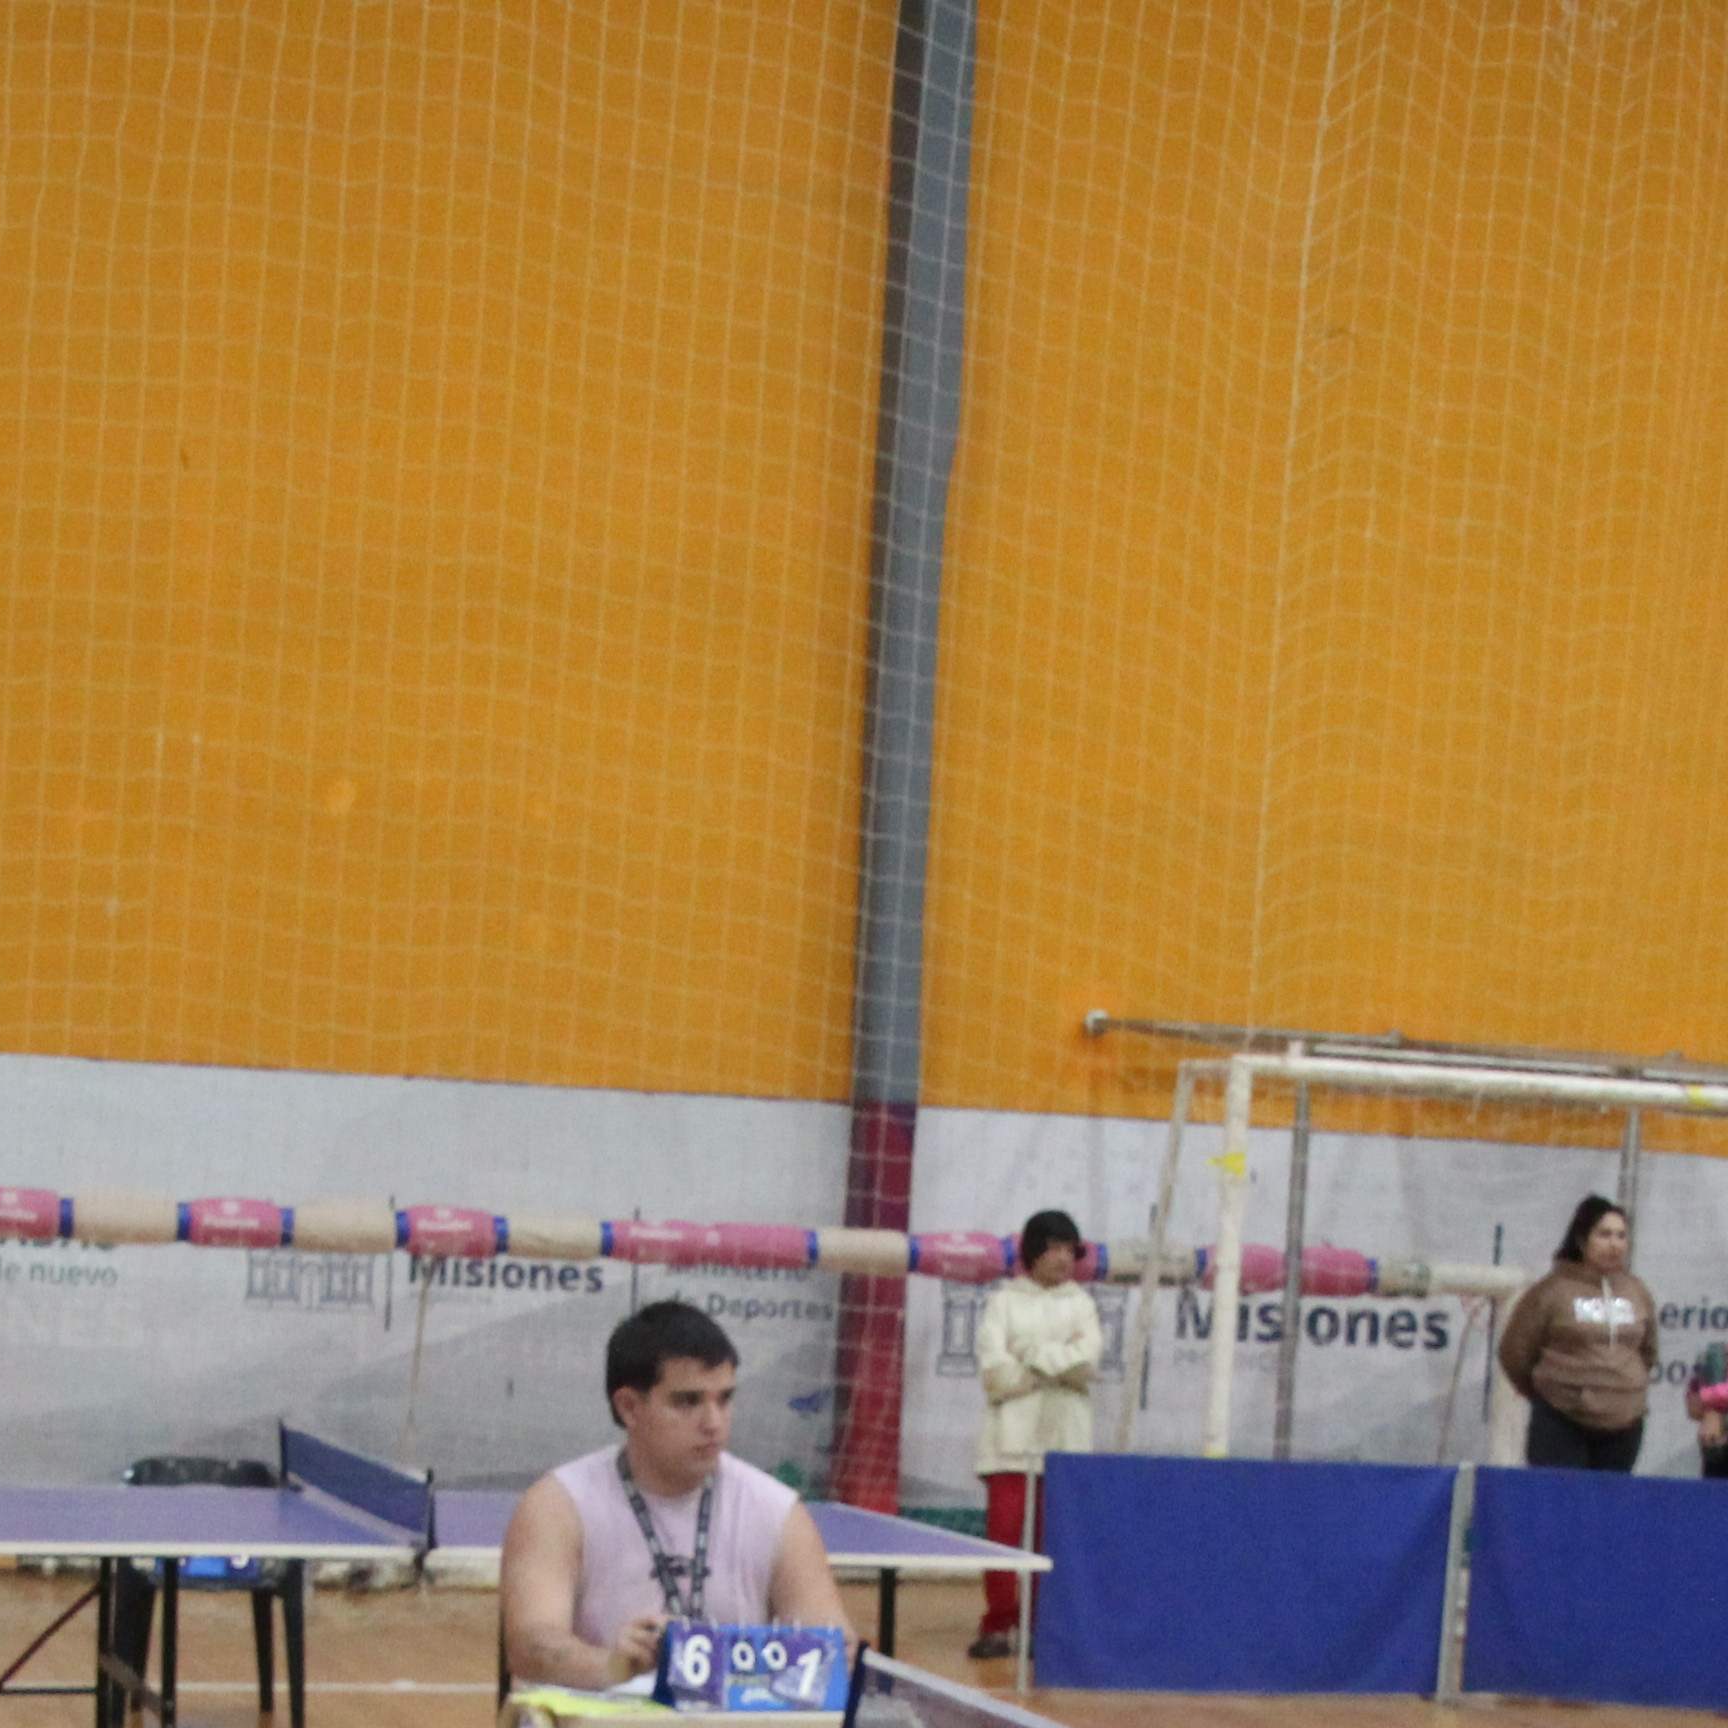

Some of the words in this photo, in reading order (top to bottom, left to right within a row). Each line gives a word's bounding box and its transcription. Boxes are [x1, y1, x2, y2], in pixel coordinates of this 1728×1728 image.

[28, 1262, 119, 1287] nuevo
[409, 1254, 605, 1294] Misiones
[706, 1290, 835, 1324] Deportes
[1174, 1288, 1451, 1351] Misones
[683, 1633, 713, 1688] 6
[731, 1641, 756, 1672] 0
[761, 1640, 788, 1671] 0
[796, 1648, 822, 1699] 1
